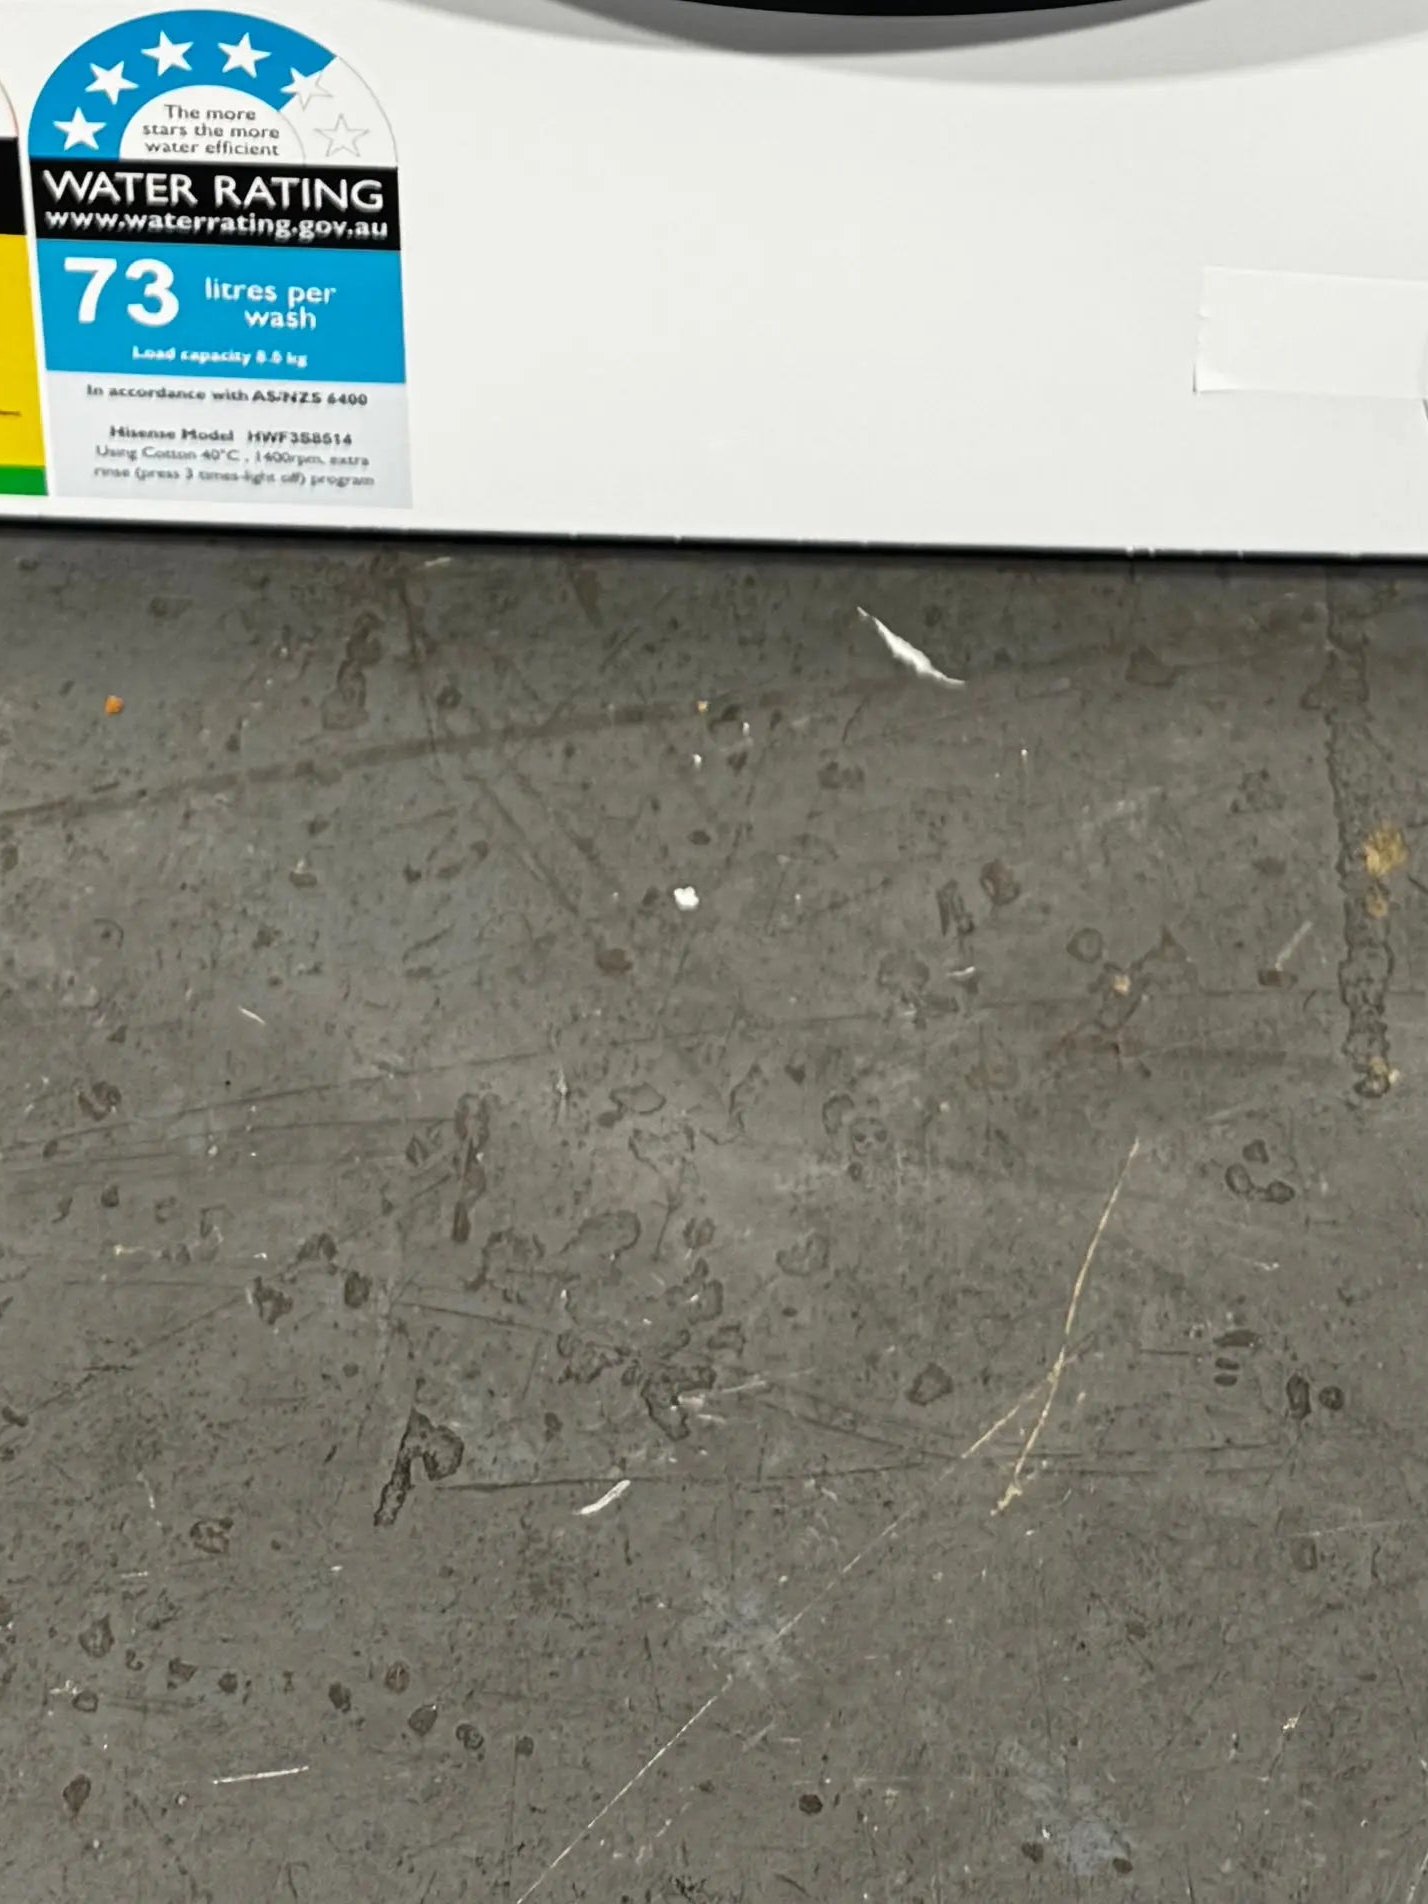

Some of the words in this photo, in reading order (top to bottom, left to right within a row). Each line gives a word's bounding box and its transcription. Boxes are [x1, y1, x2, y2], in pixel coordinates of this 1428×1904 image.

[164, 104, 201, 120] The
[206, 108, 256, 120] more
[142, 122, 188, 136] stars
[194, 123, 224, 138] the
[230, 127, 280, 139] more
[145, 142, 201, 153] water
[205, 141, 280, 157] efficient
[42, 169, 198, 208] WATER
[213, 174, 385, 212] RATING
[45, 210, 389, 242] www.waterrating.gov.au
[63, 256, 180, 327] 73
[205, 276, 278, 304] litres
[287, 285, 337, 309] per
[244, 305, 317, 330] wash
[132, 345, 176, 362] Load
[180, 348, 252, 367] capacity
[286, 351, 309, 369] kg
[86, 384, 103, 397] In
[108, 385, 206, 400] accordance
[211, 388, 249, 401] with
[109, 424, 176, 440] Hisense
[180, 427, 235, 441] Model
[141, 445, 197, 460] Cotton
